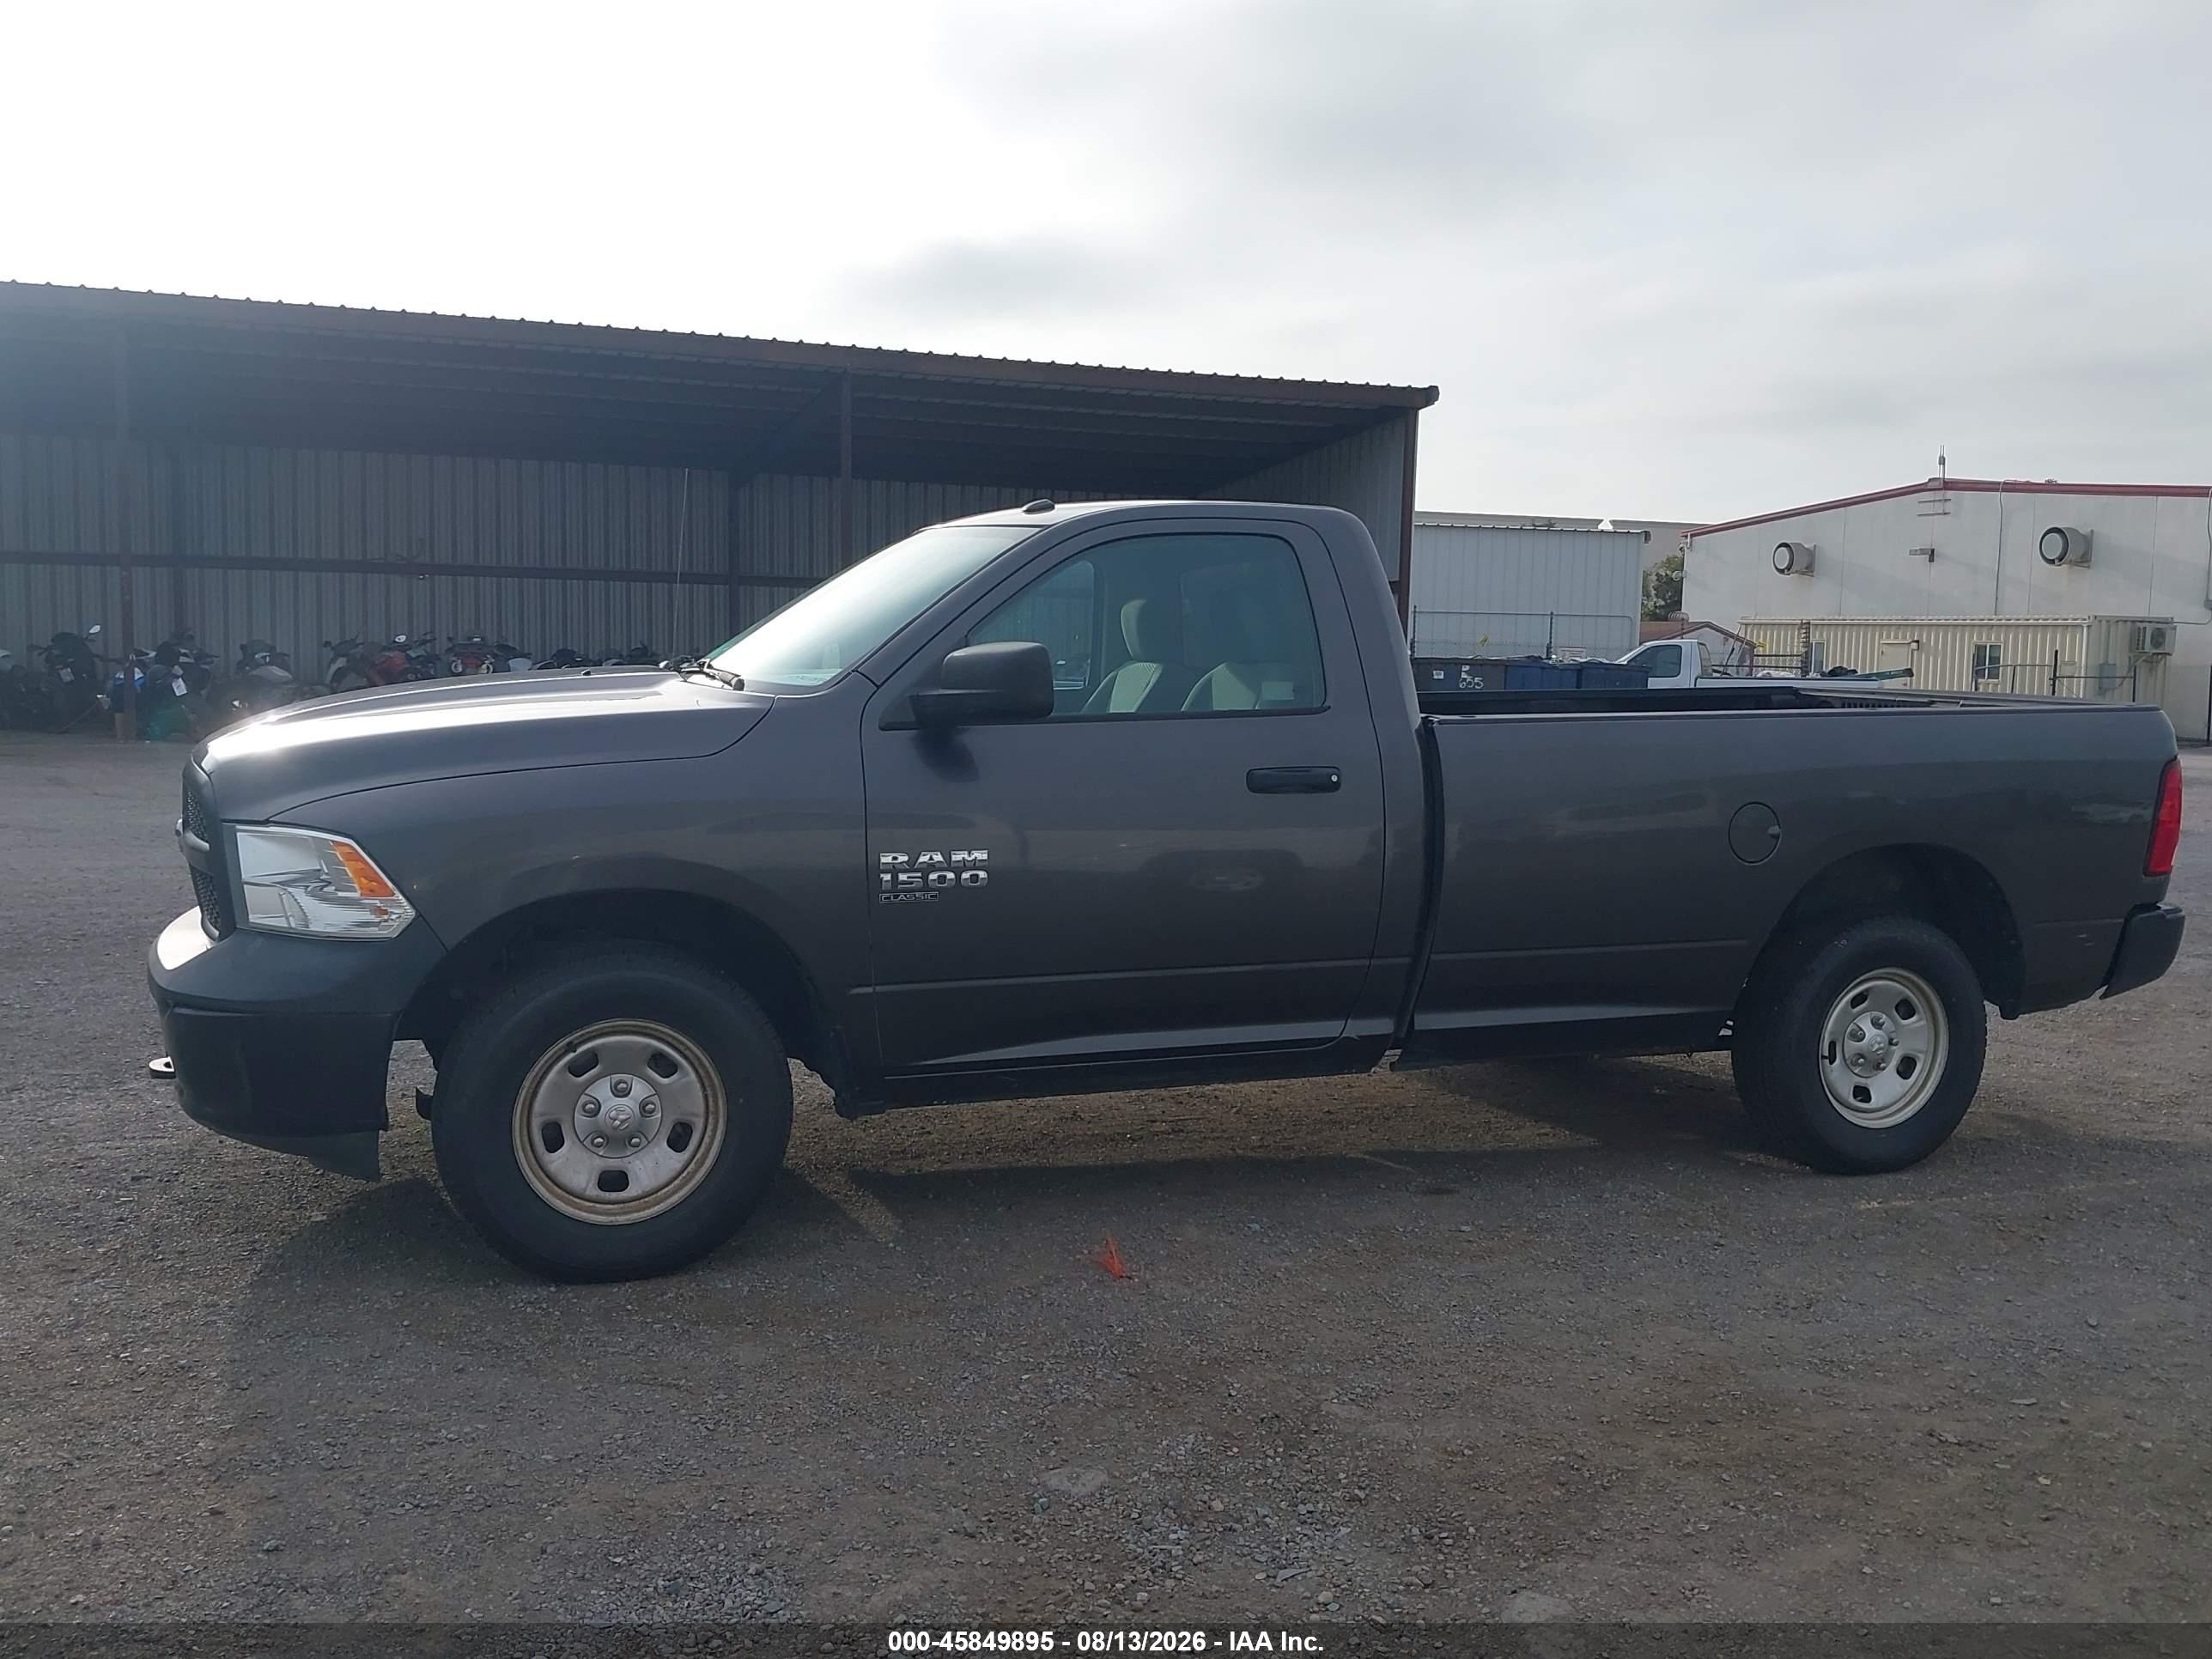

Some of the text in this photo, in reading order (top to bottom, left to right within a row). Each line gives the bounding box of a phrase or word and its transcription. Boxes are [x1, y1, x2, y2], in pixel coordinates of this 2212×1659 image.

[879, 850, 988, 869] RAM
[879, 870, 988, 890] 1500
[881, 893, 938, 902] CLASSIC
